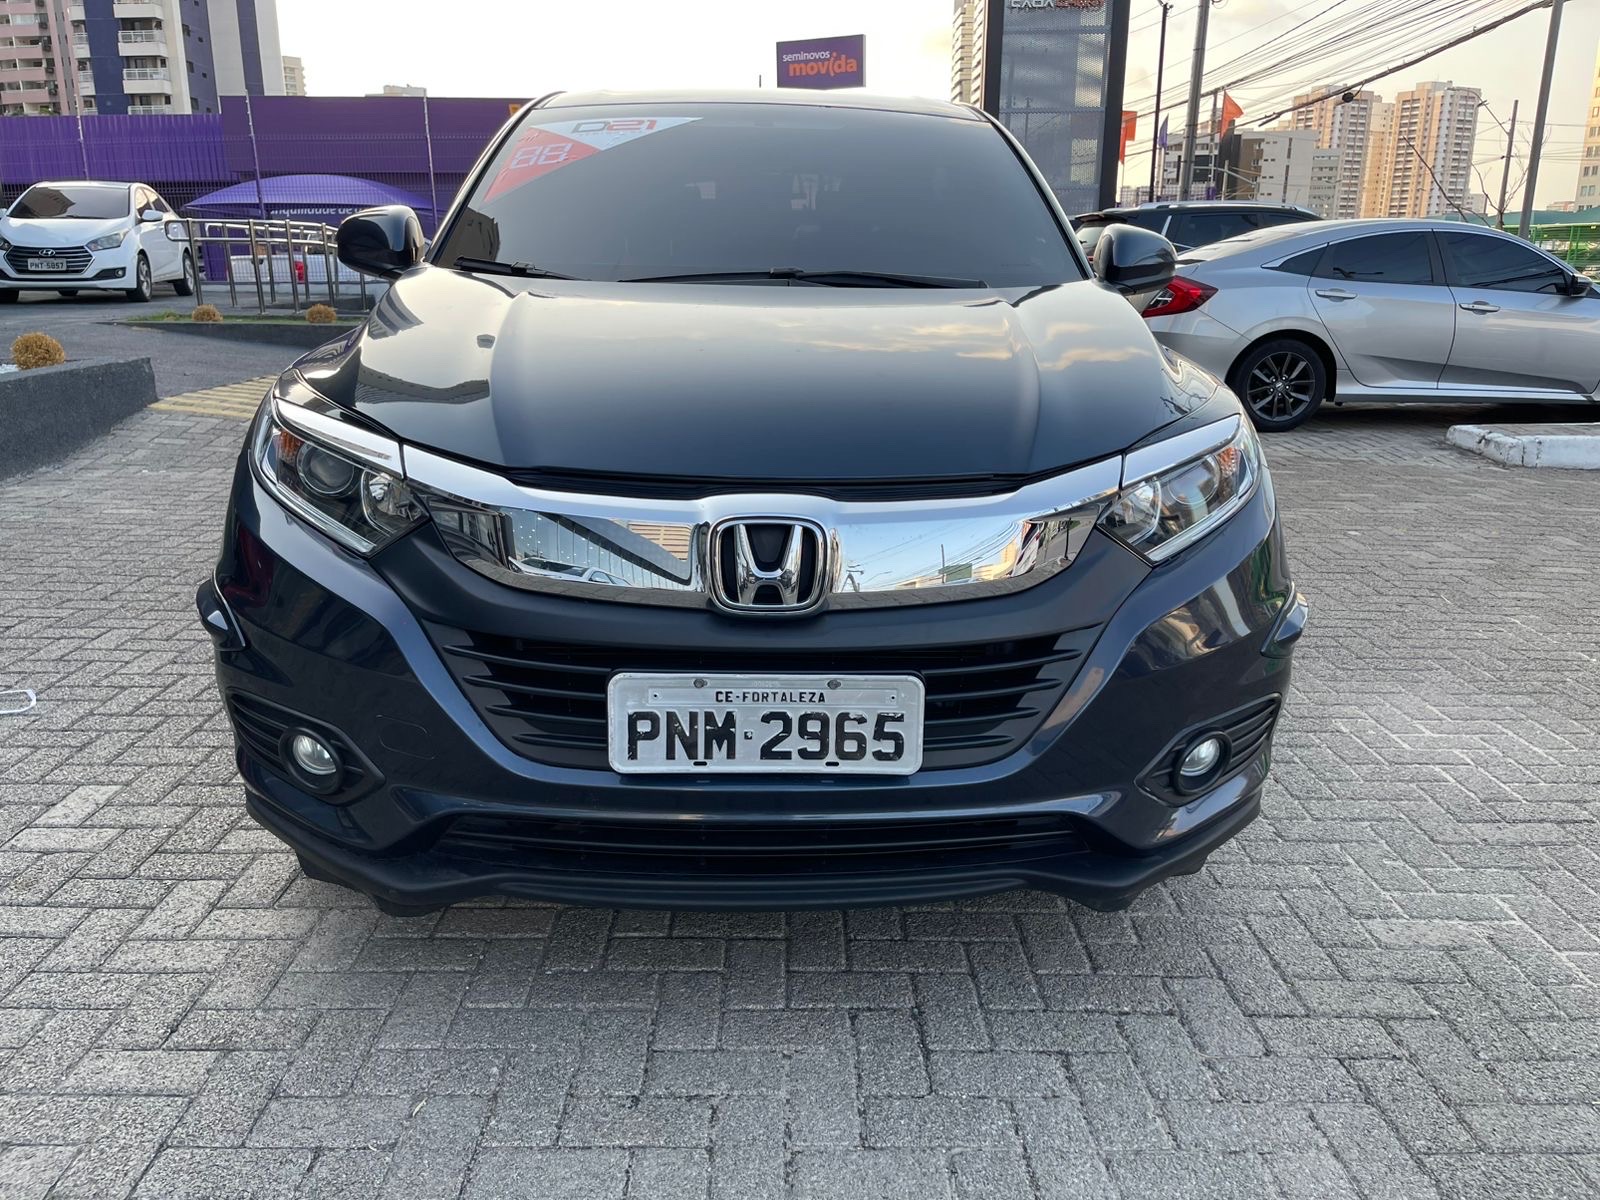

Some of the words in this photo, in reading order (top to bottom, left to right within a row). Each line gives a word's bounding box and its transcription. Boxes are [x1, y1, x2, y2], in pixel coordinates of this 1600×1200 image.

[782, 51, 831, 62] seminovos
[788, 52, 858, 77] movida
[714, 690, 827, 704] CE-FORTALEZA
